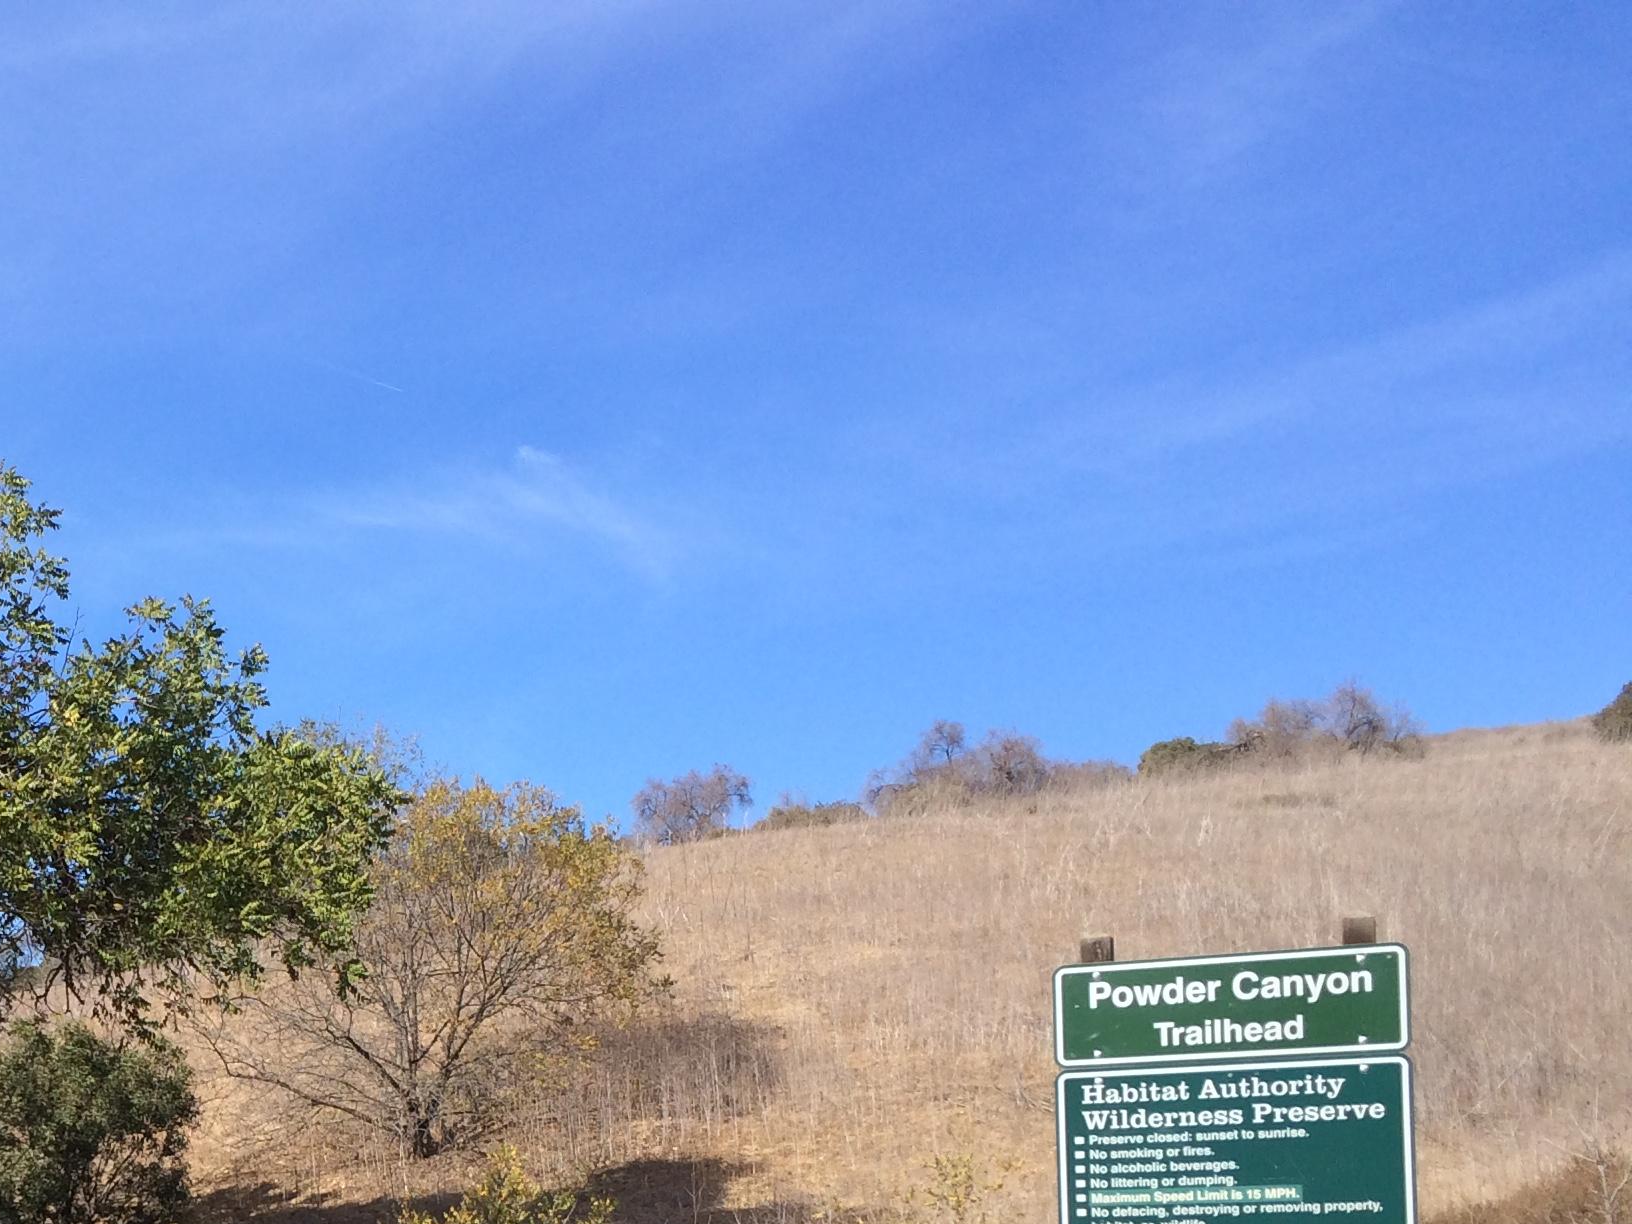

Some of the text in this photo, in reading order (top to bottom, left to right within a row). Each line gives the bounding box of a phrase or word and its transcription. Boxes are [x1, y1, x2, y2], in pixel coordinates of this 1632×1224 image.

[1089, 969, 1373, 1008] Powder Canyon
[1153, 1015, 1304, 1047] Trailhead
[1081, 1075, 1346, 1104] Habitat Authority
[1082, 1100, 1386, 1130] Wilderness Preserve
[1089, 1127, 1309, 1145] Preserve closed: sunset to sunrise.
[1089, 1150, 1107, 1159] No
[1111, 1148, 1163, 1159] smoking
[1183, 1146, 1215, 1156] fires.
[1090, 1161, 1239, 1174] No alcoholic beverages.
[1090, 1175, 1237, 1188] No littering or dumping.
[1091, 1188, 1300, 1204] Maximum Speed Limit is 15 MPH.
[1091, 1200, 1383, 1218] No defacing, destroying or removing property,
